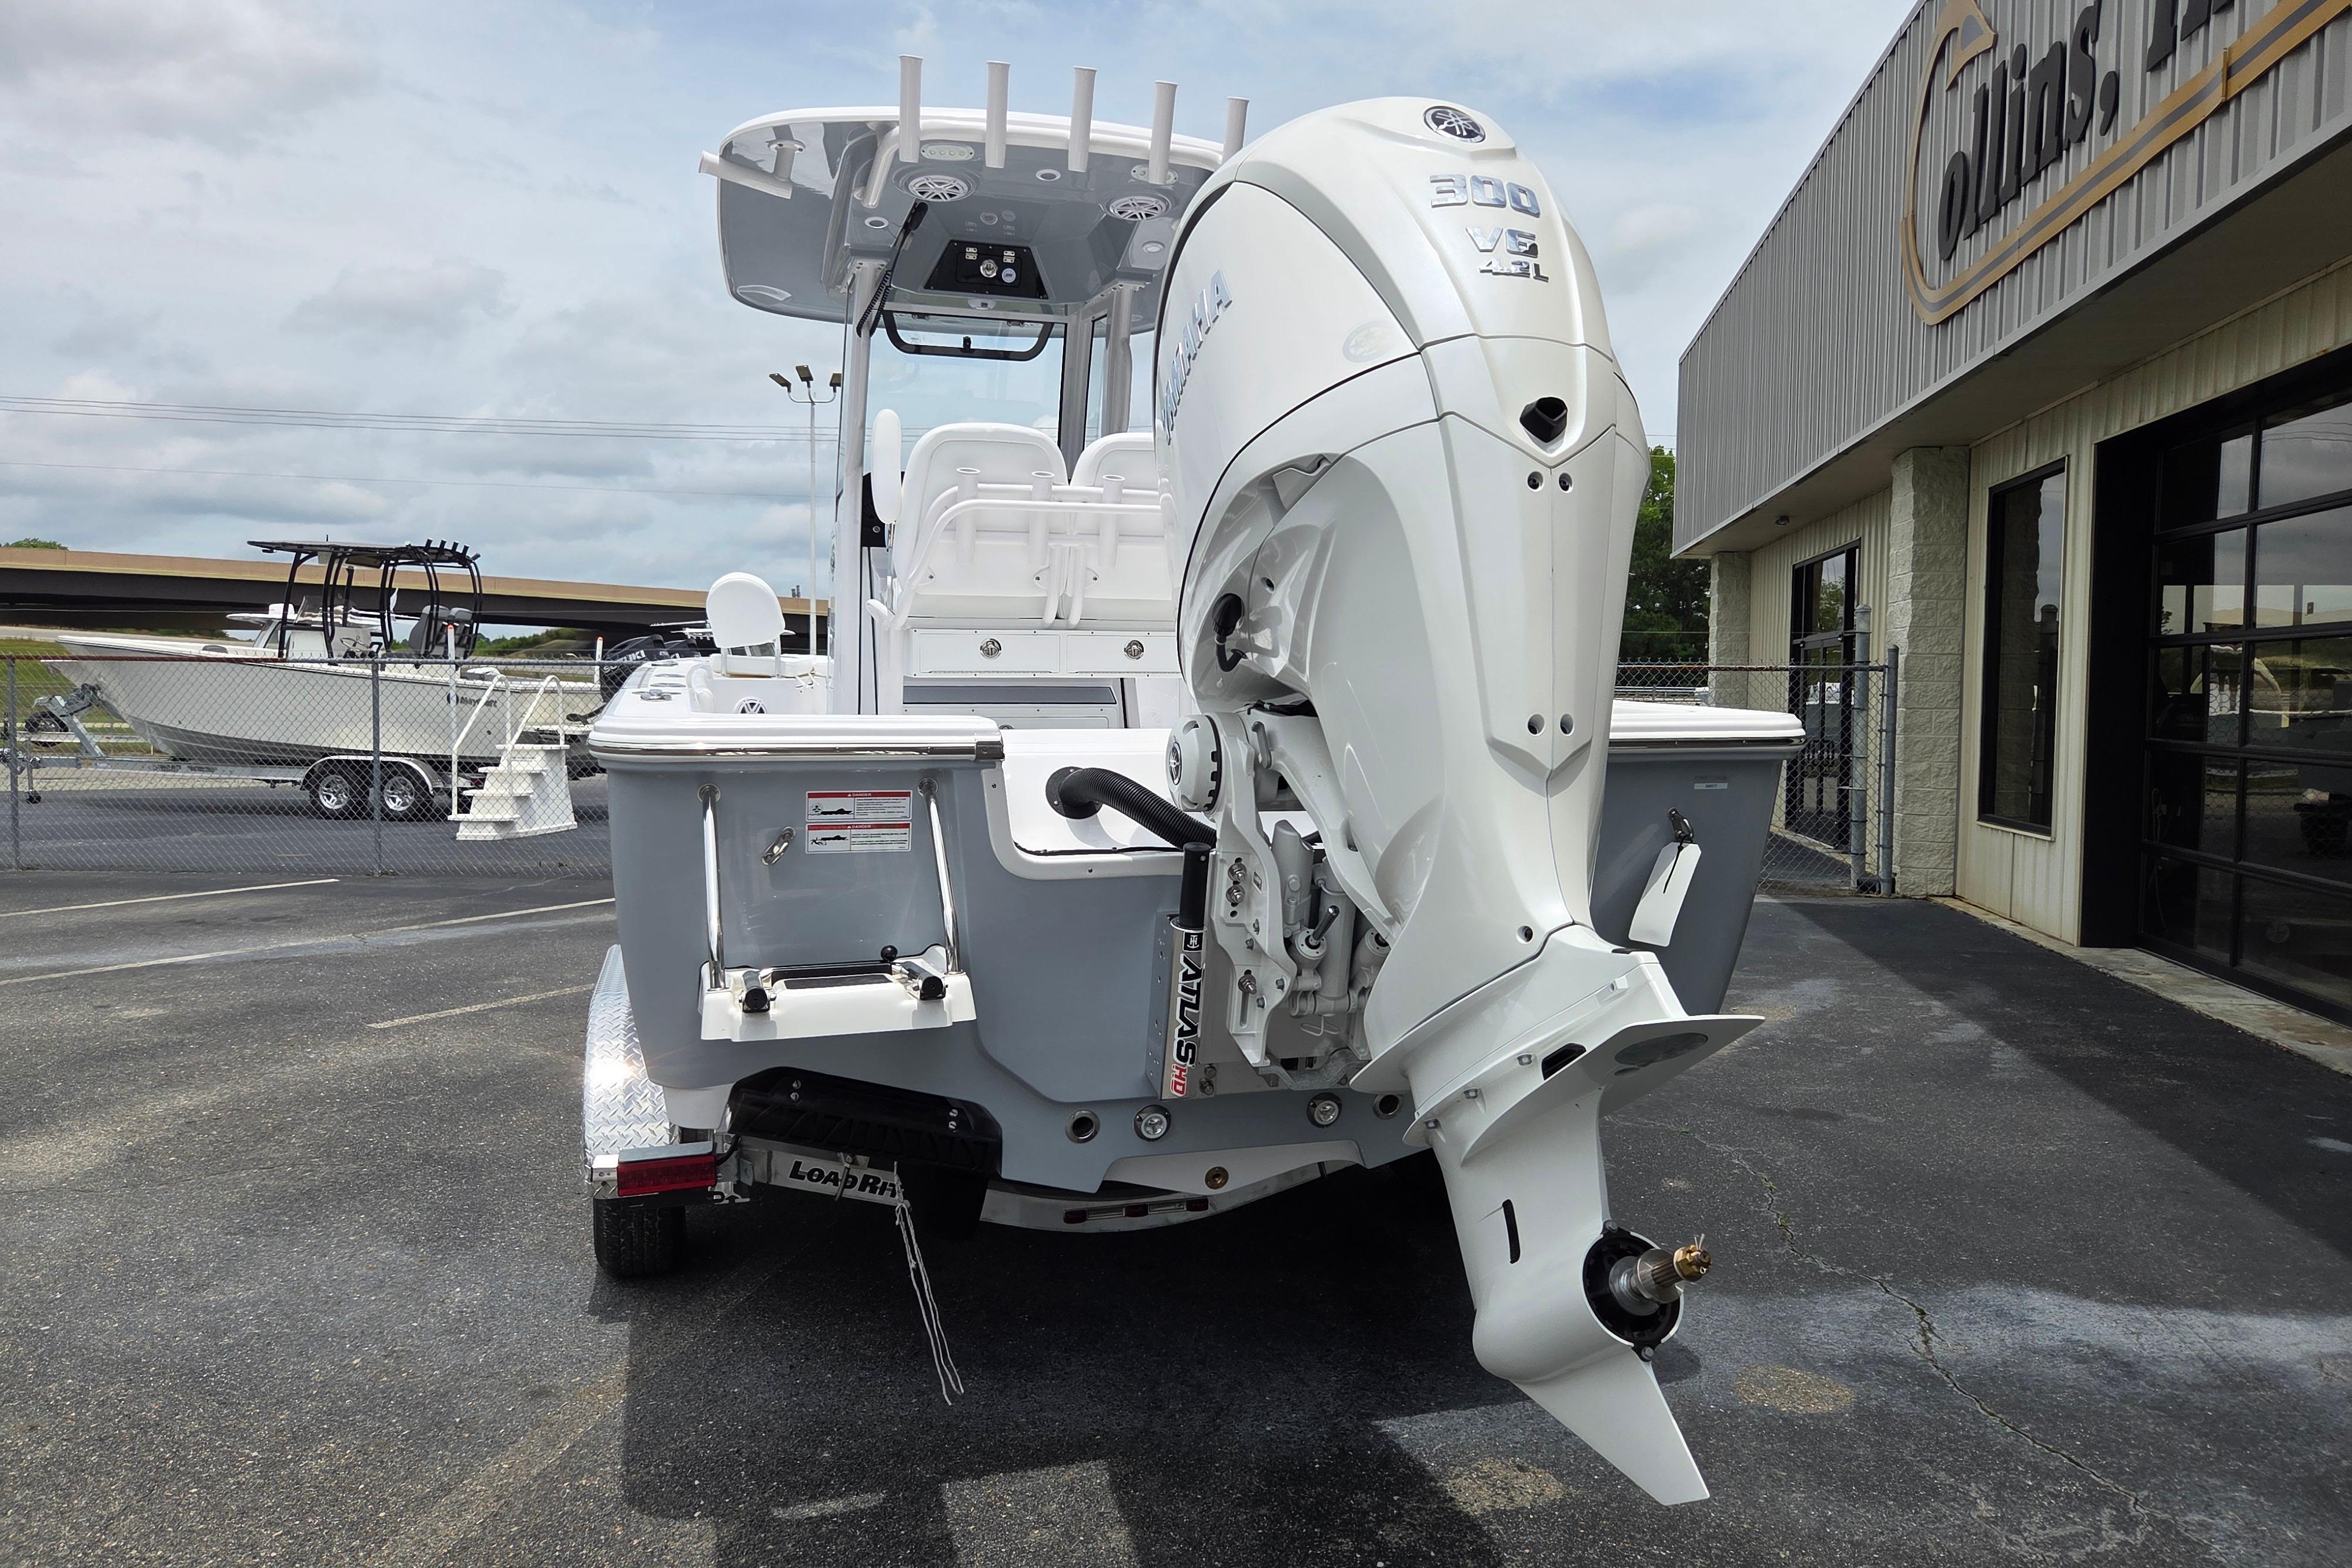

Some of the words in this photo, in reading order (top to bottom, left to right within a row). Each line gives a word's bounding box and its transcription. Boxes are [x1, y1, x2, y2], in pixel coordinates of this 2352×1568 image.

[1429, 175, 1540, 218] 300
[1466, 226, 1538, 258] V6
[1479, 259, 1549, 282] 4.2L
[1162, 269, 1232, 445] YAMAHA
[1175, 954, 1204, 1068] ATLAS
[1171, 1064, 1188, 1096] HD
